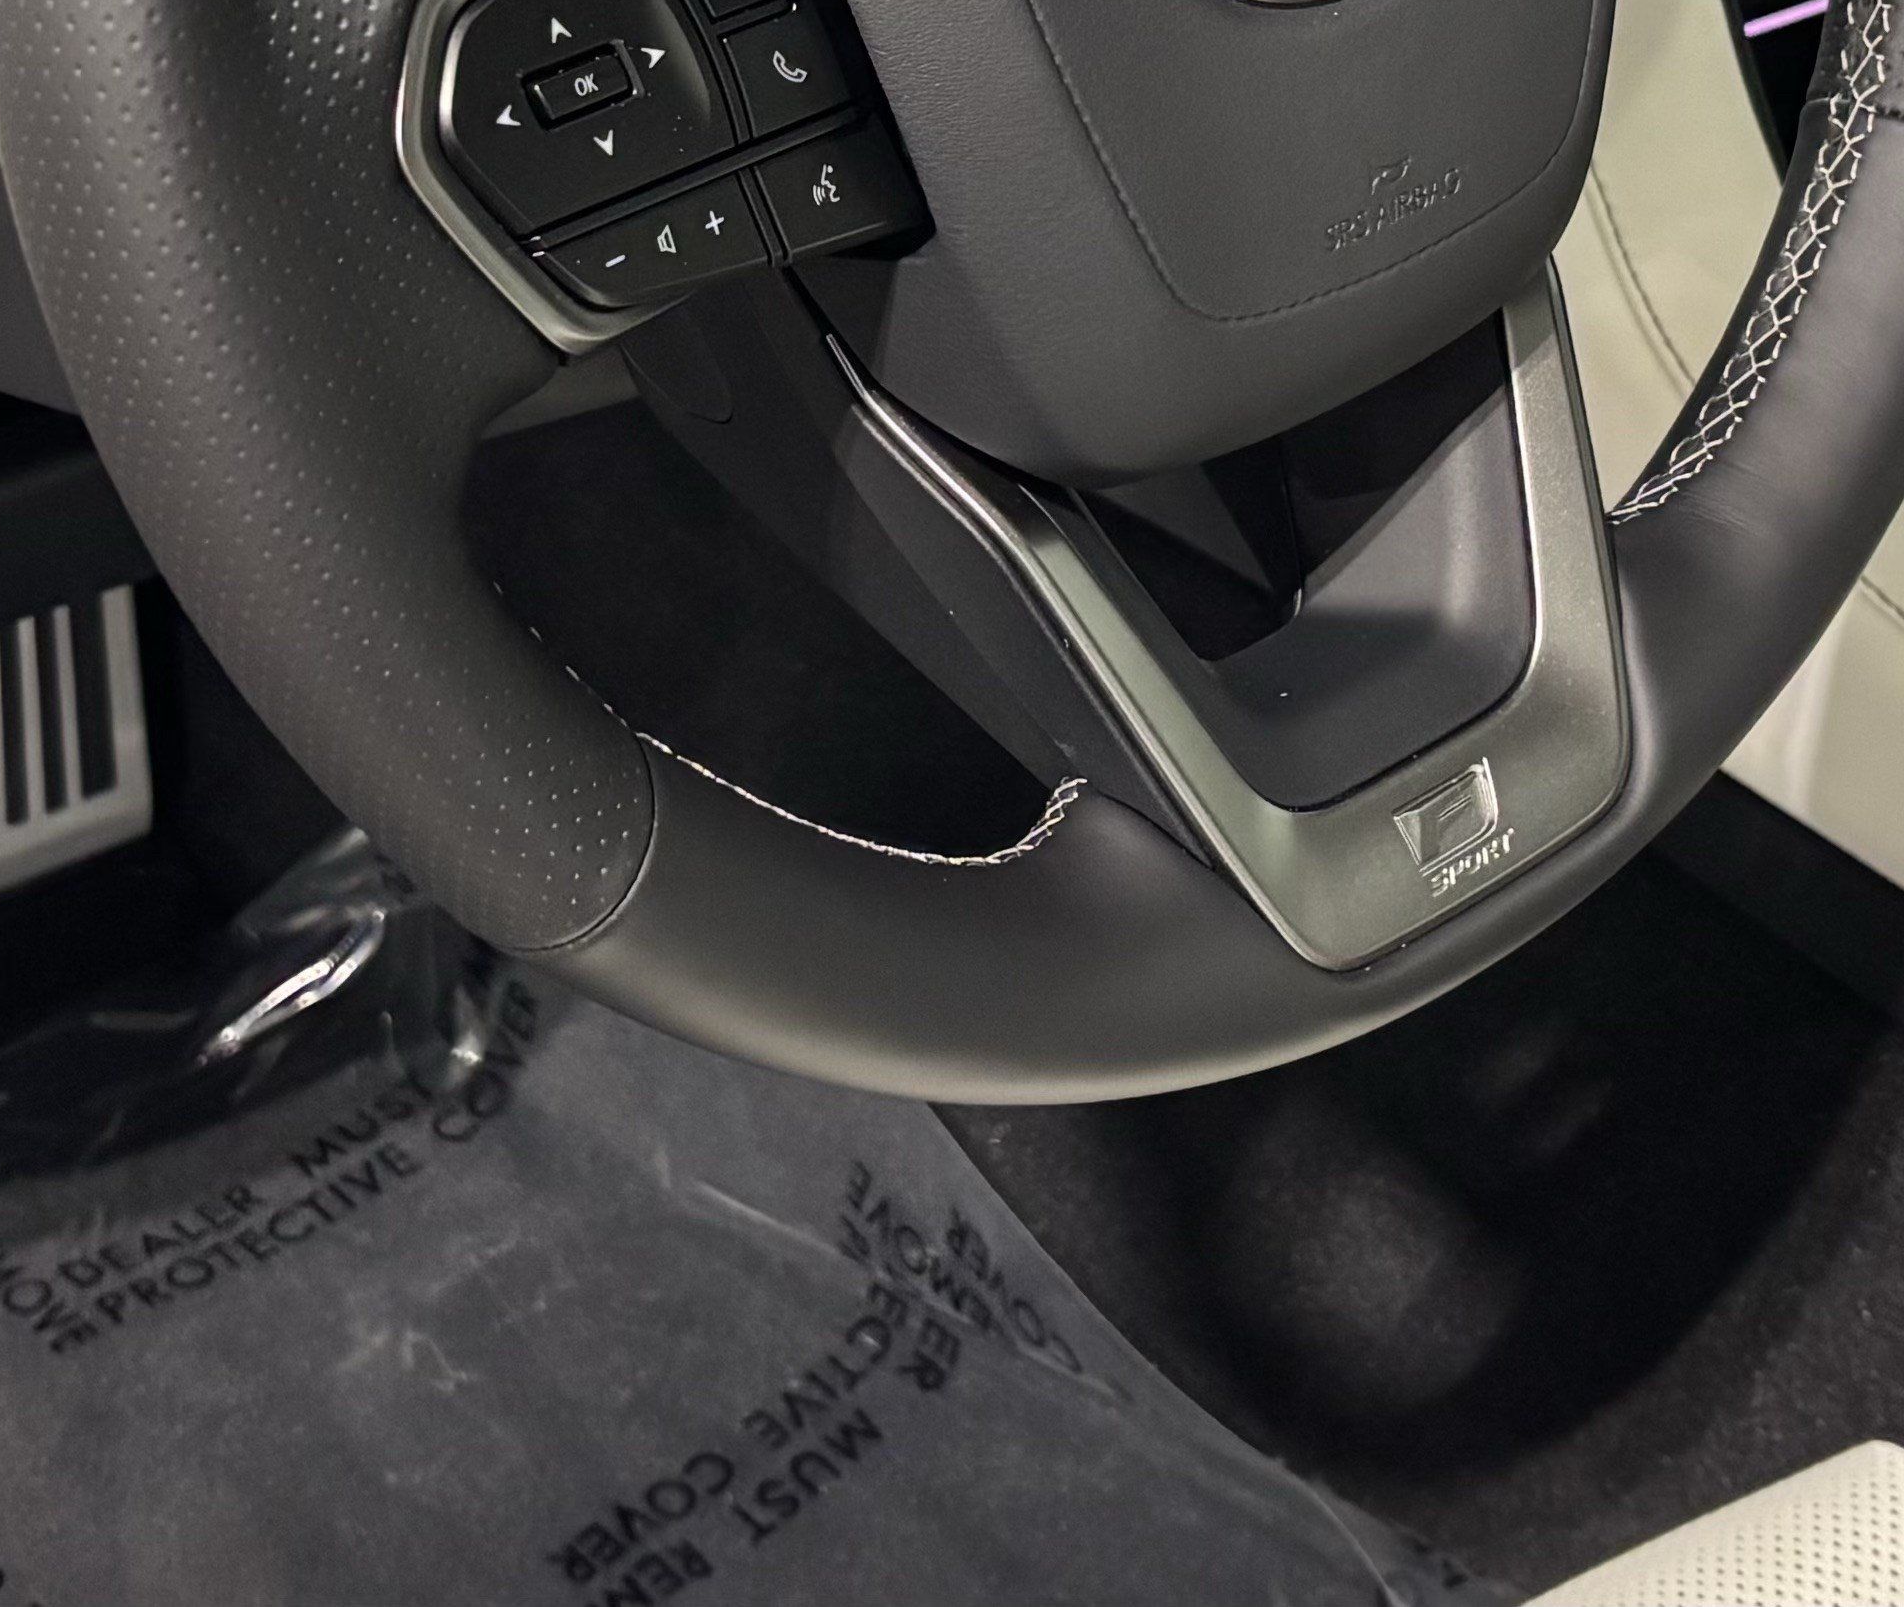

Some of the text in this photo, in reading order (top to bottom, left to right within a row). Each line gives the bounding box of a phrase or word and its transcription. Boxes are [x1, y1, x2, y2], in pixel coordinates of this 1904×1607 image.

[574, 74, 598, 97] OK
[97, 1141, 421, 1326] PROTECTIVE
[547, 1452, 734, 1584] COVER
[730, 1407, 884, 1544] MUST
